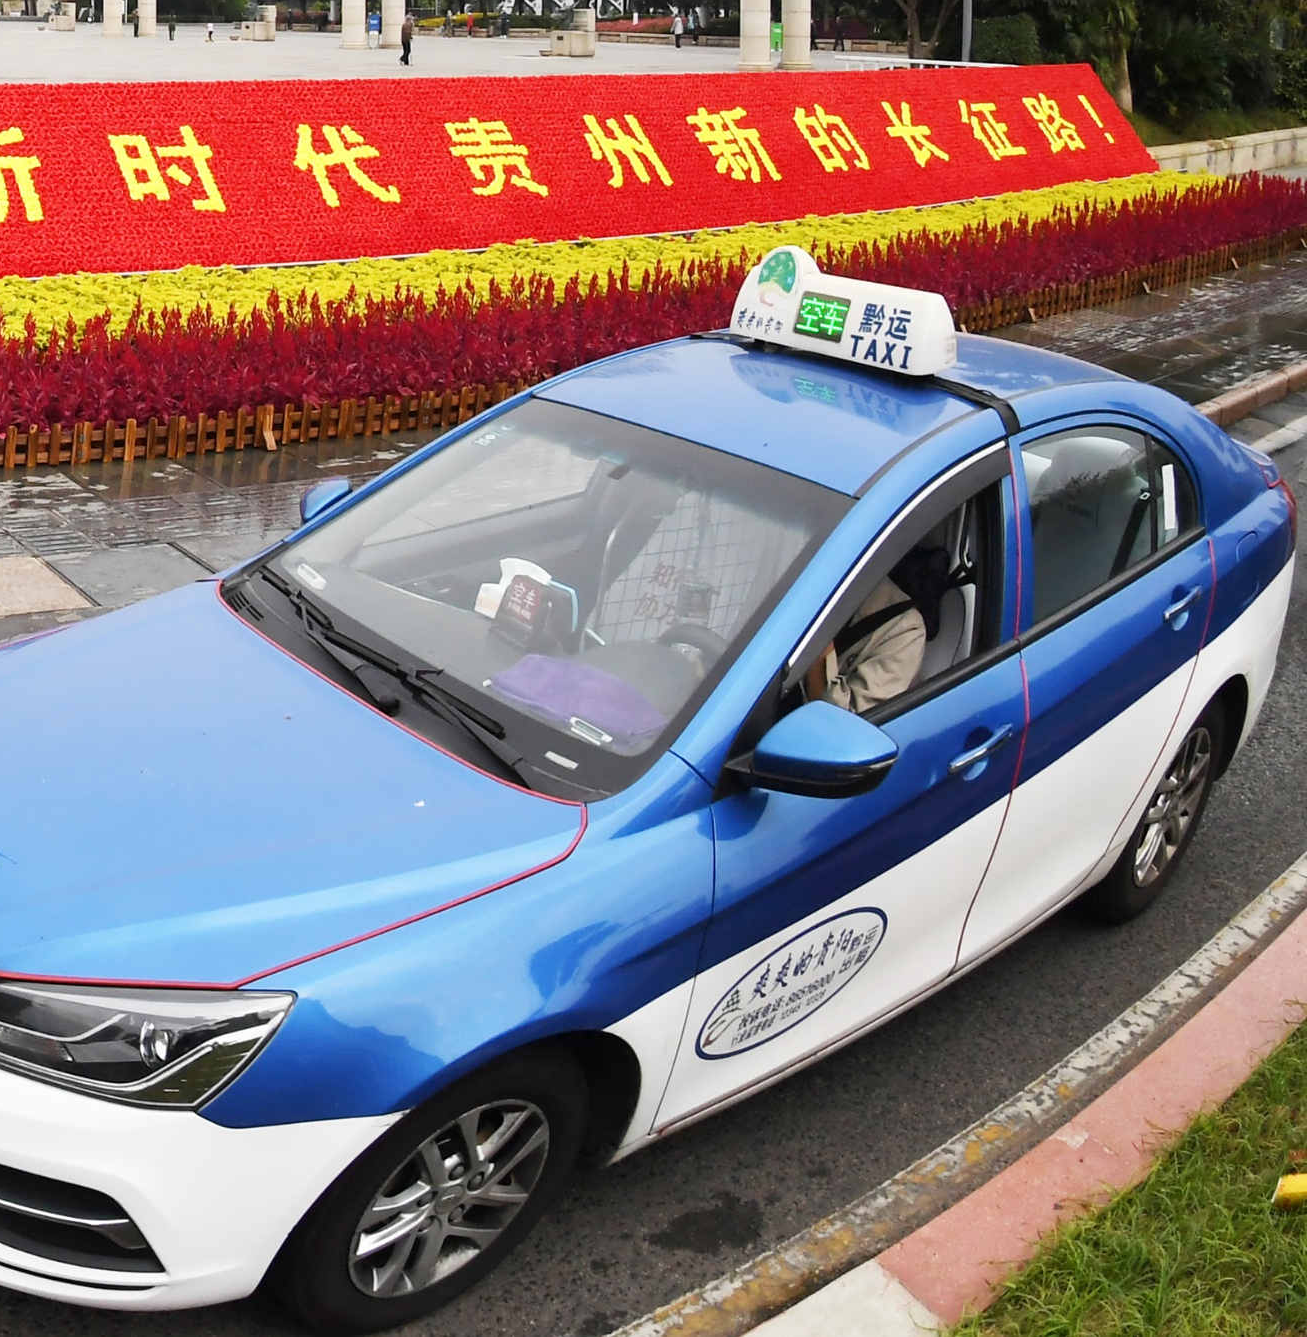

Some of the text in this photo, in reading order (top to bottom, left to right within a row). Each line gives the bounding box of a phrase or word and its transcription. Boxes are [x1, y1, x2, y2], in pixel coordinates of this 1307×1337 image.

[796, 297, 848, 335] 空车
[858, 303, 912, 341] 黔运
[850, 335, 913, 370] TAXI
[511, 583, 536, 609] 空车
